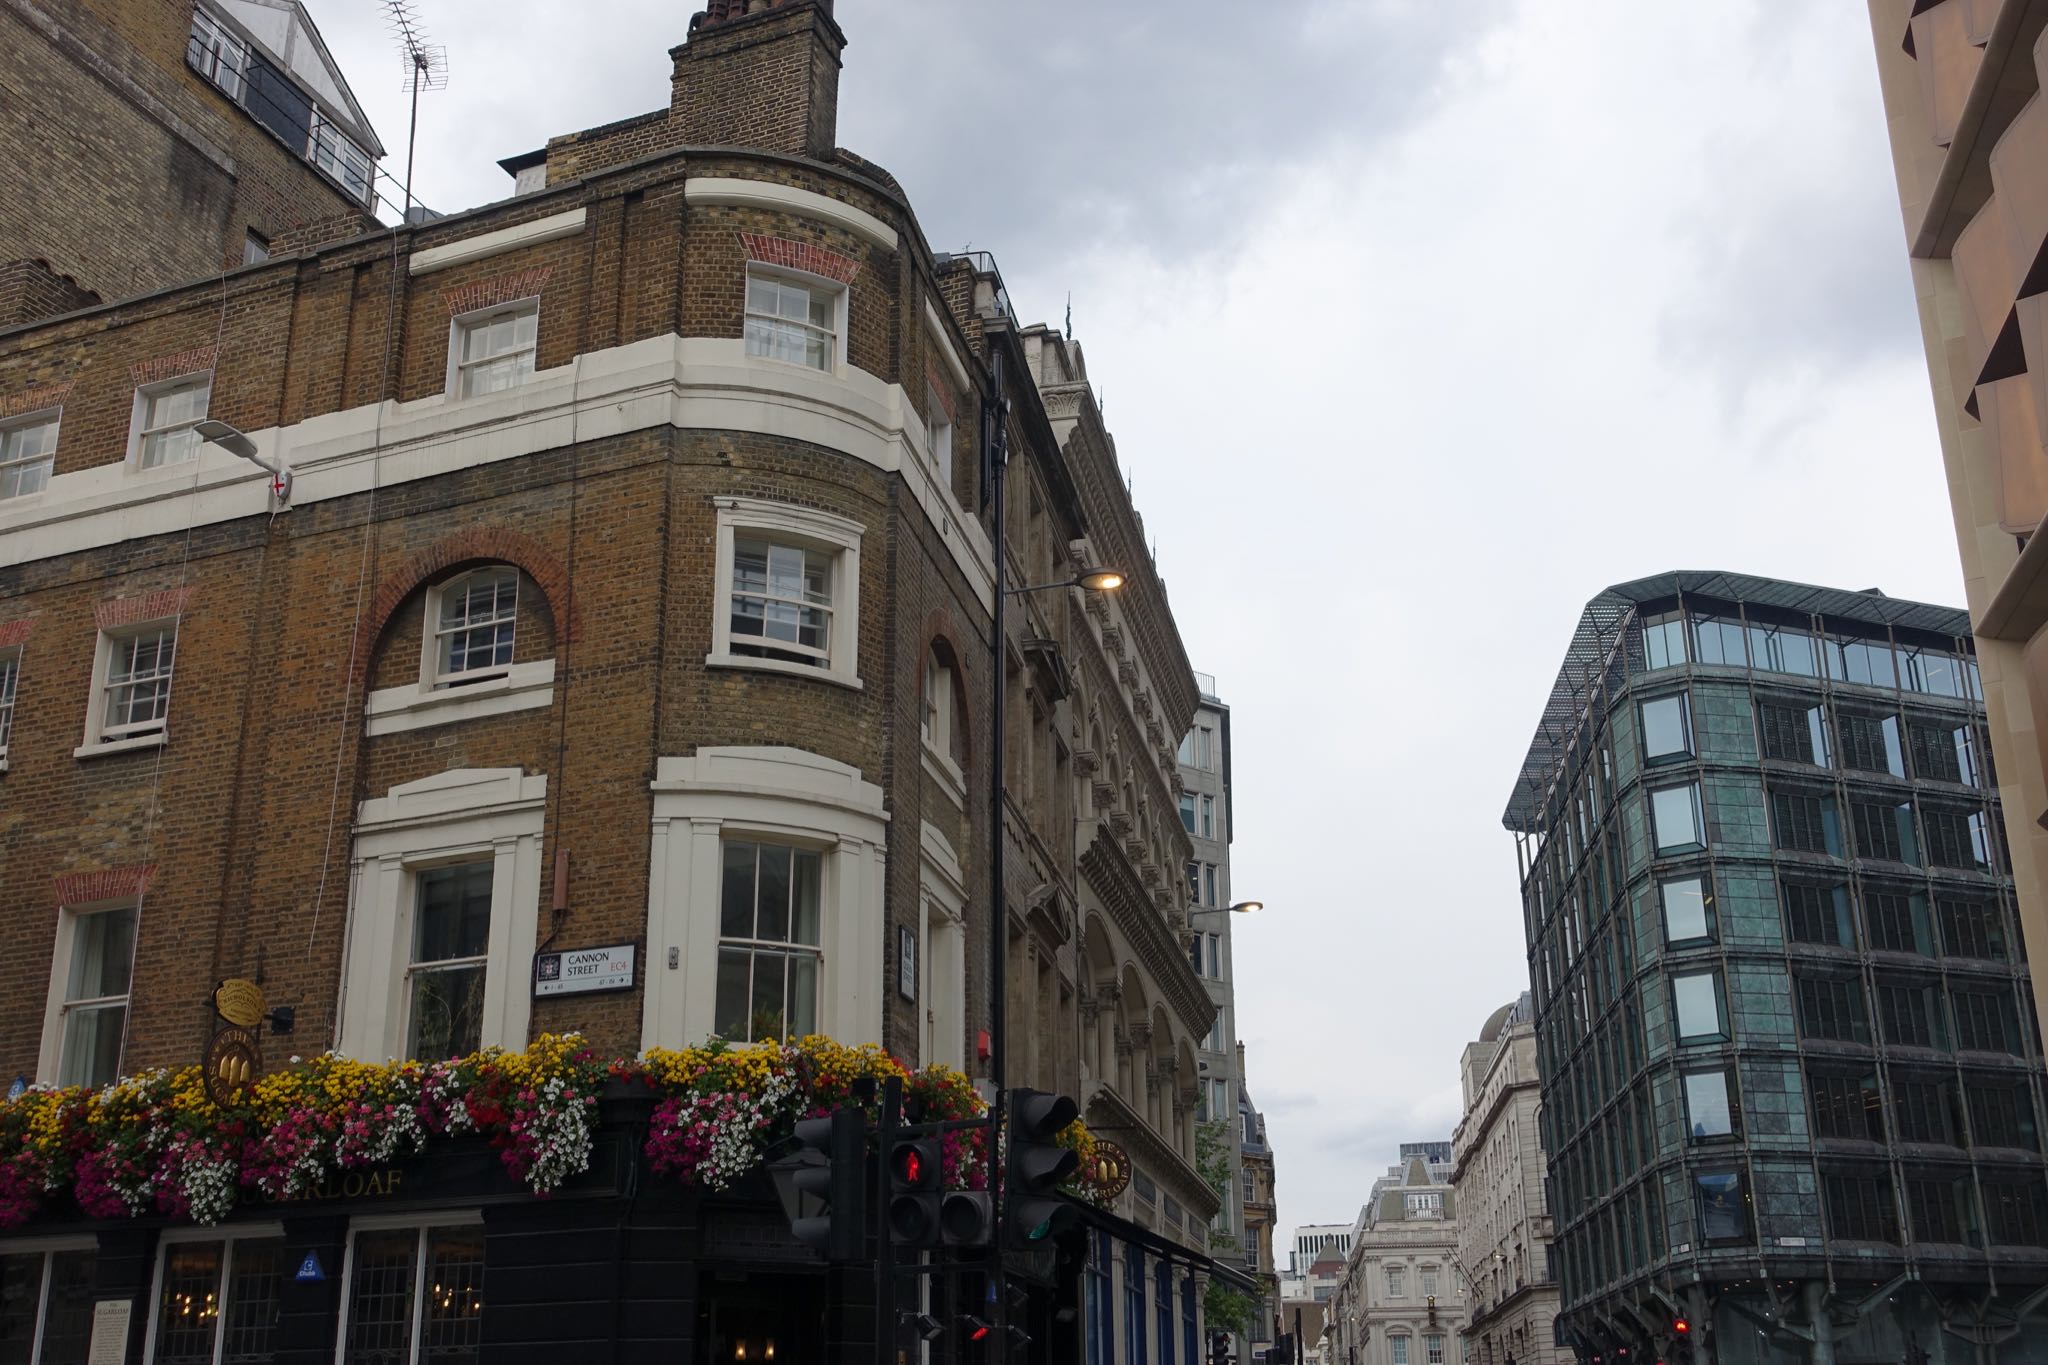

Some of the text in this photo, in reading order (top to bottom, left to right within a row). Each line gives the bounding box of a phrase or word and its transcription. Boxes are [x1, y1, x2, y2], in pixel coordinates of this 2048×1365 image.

[568, 951, 609, 965] CANNON
[567, 961, 627, 976] STREET EC4
[231, 1169, 402, 1205] URLOAF
